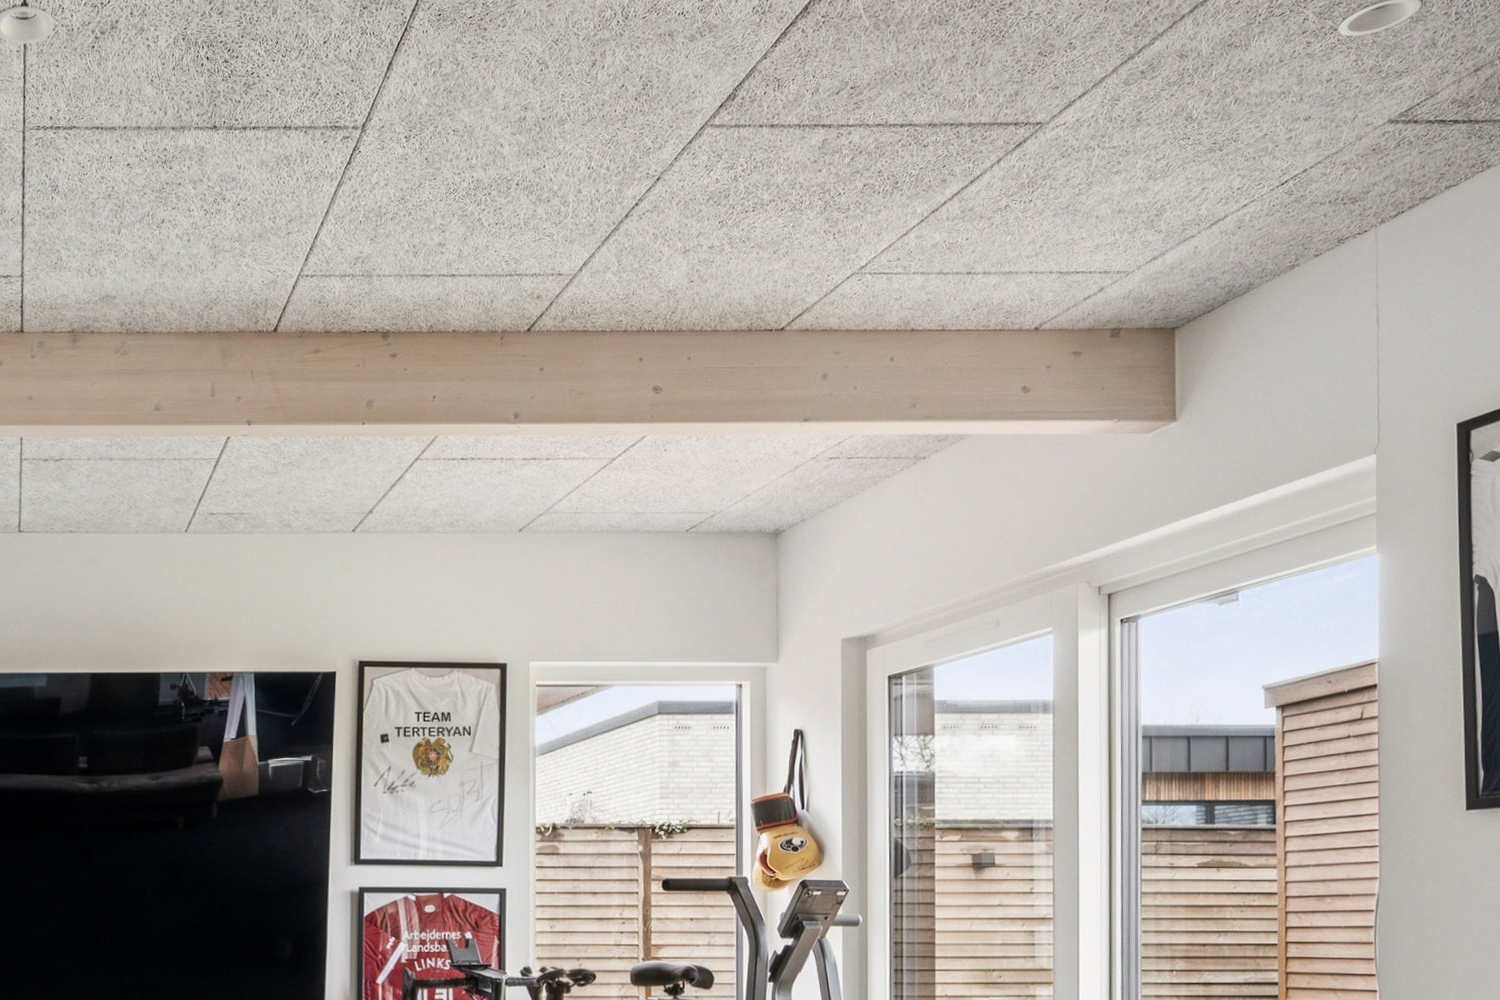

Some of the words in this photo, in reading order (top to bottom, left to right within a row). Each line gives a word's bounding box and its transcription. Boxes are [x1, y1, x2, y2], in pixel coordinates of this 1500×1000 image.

[414, 711, 452, 722] TEAM
[394, 726, 472, 737] TERTERYAN
[403, 929, 462, 942] Arbejdernes
[405, 941, 458, 953] Landsba
[414, 957, 452, 972] LINKS
